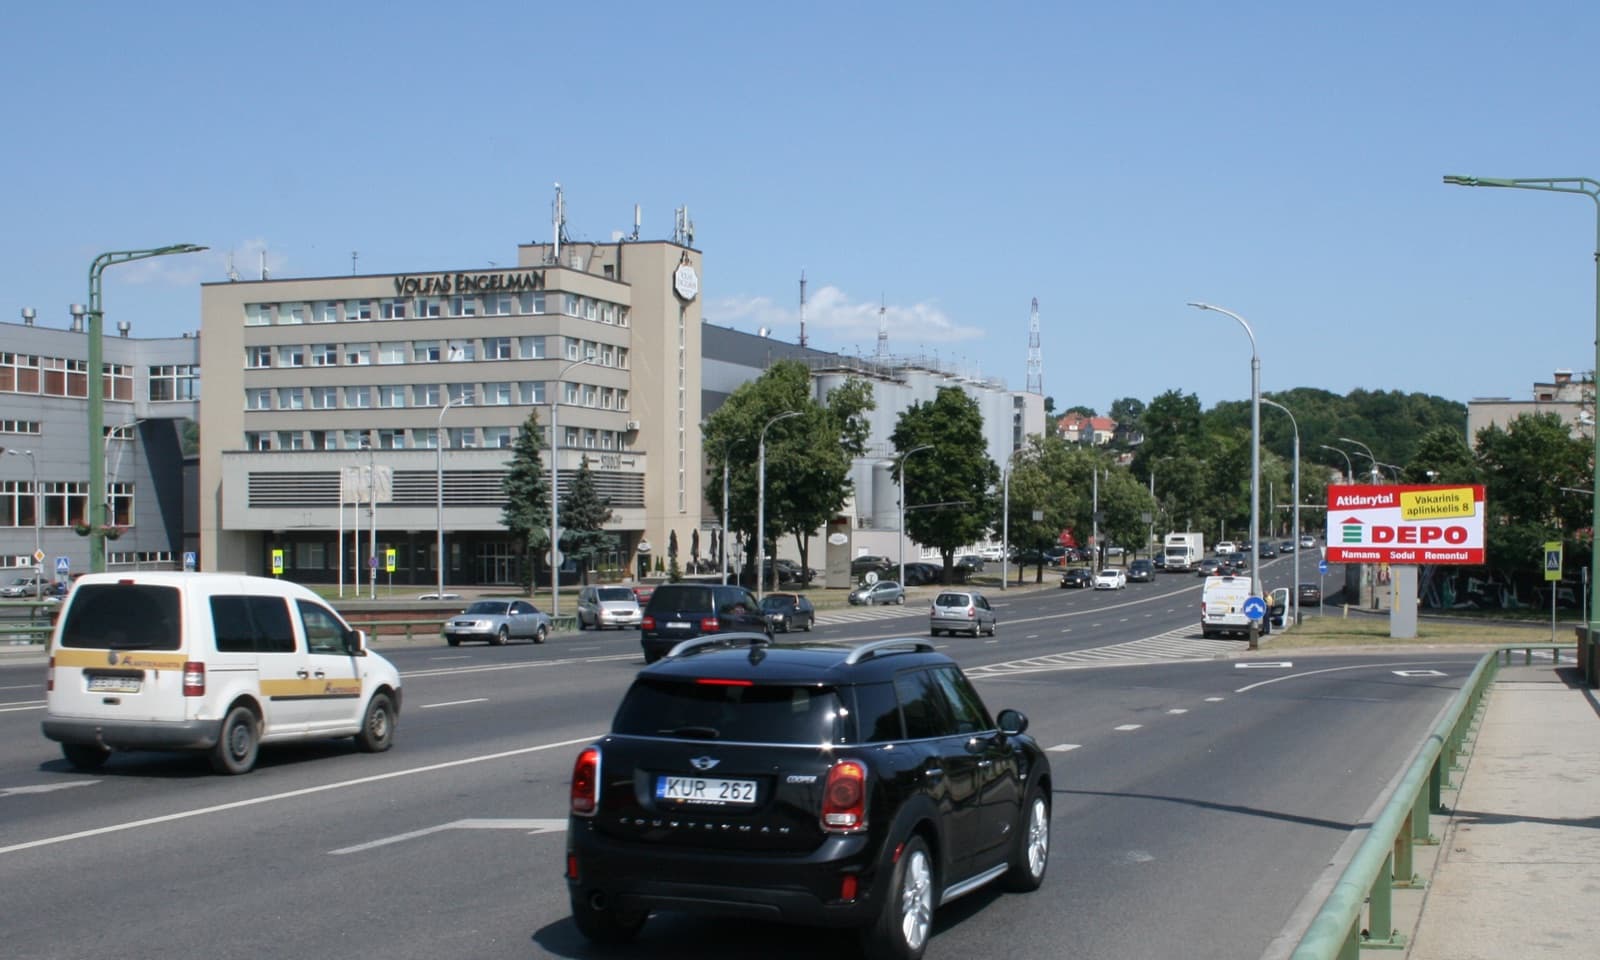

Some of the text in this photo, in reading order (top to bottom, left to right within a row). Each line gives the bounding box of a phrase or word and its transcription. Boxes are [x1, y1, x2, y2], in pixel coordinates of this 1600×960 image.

[395, 270, 546, 295] VOLFAS ENGELMAN
[1415, 494, 1460, 504] Vakarinis
[1407, 503, 1469, 516] aplinkkelis 8
[1371, 526, 1468, 544] DEPO
[1341, 550, 1468, 560] Namams Sodui Remontui
[786, 775, 817, 784] COOPER
[667, 779, 754, 800] KUR 262
